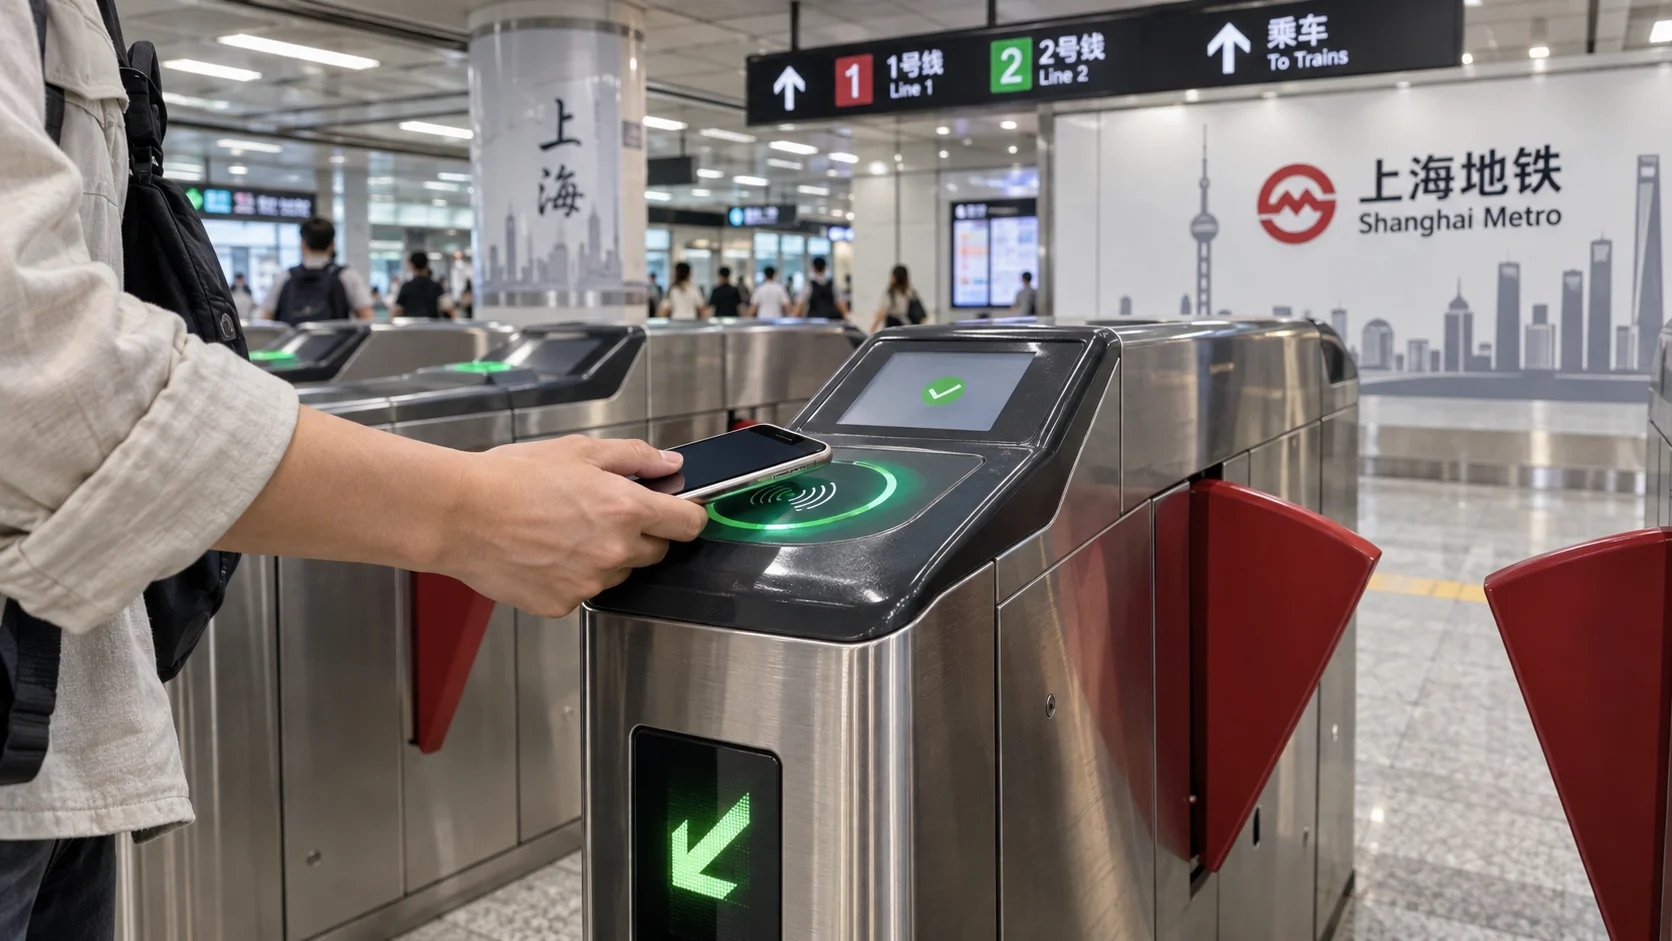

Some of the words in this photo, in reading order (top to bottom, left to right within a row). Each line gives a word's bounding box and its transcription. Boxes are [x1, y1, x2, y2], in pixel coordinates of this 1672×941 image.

[1267, 13, 1328, 49] 乘车
[886, 49, 944, 79] 1号线
[1039, 32, 1106, 65] 2号线
[1267, 53, 1290, 71] To
[1293, 48, 1349, 68] Trains
[845, 63, 859, 98] 1
[1000, 47, 1023, 84] 2
[1039, 68, 1073, 86] Line
[1076, 64, 1089, 82] 2
[889, 81, 921, 99] Line
[924, 78, 933, 96] 1
[539, 98, 584, 217] 上海
[1359, 145, 1562, 203] 上海地铁
[1359, 207, 1474, 237] Shanghai
[1484, 205, 1562, 228] Metro
